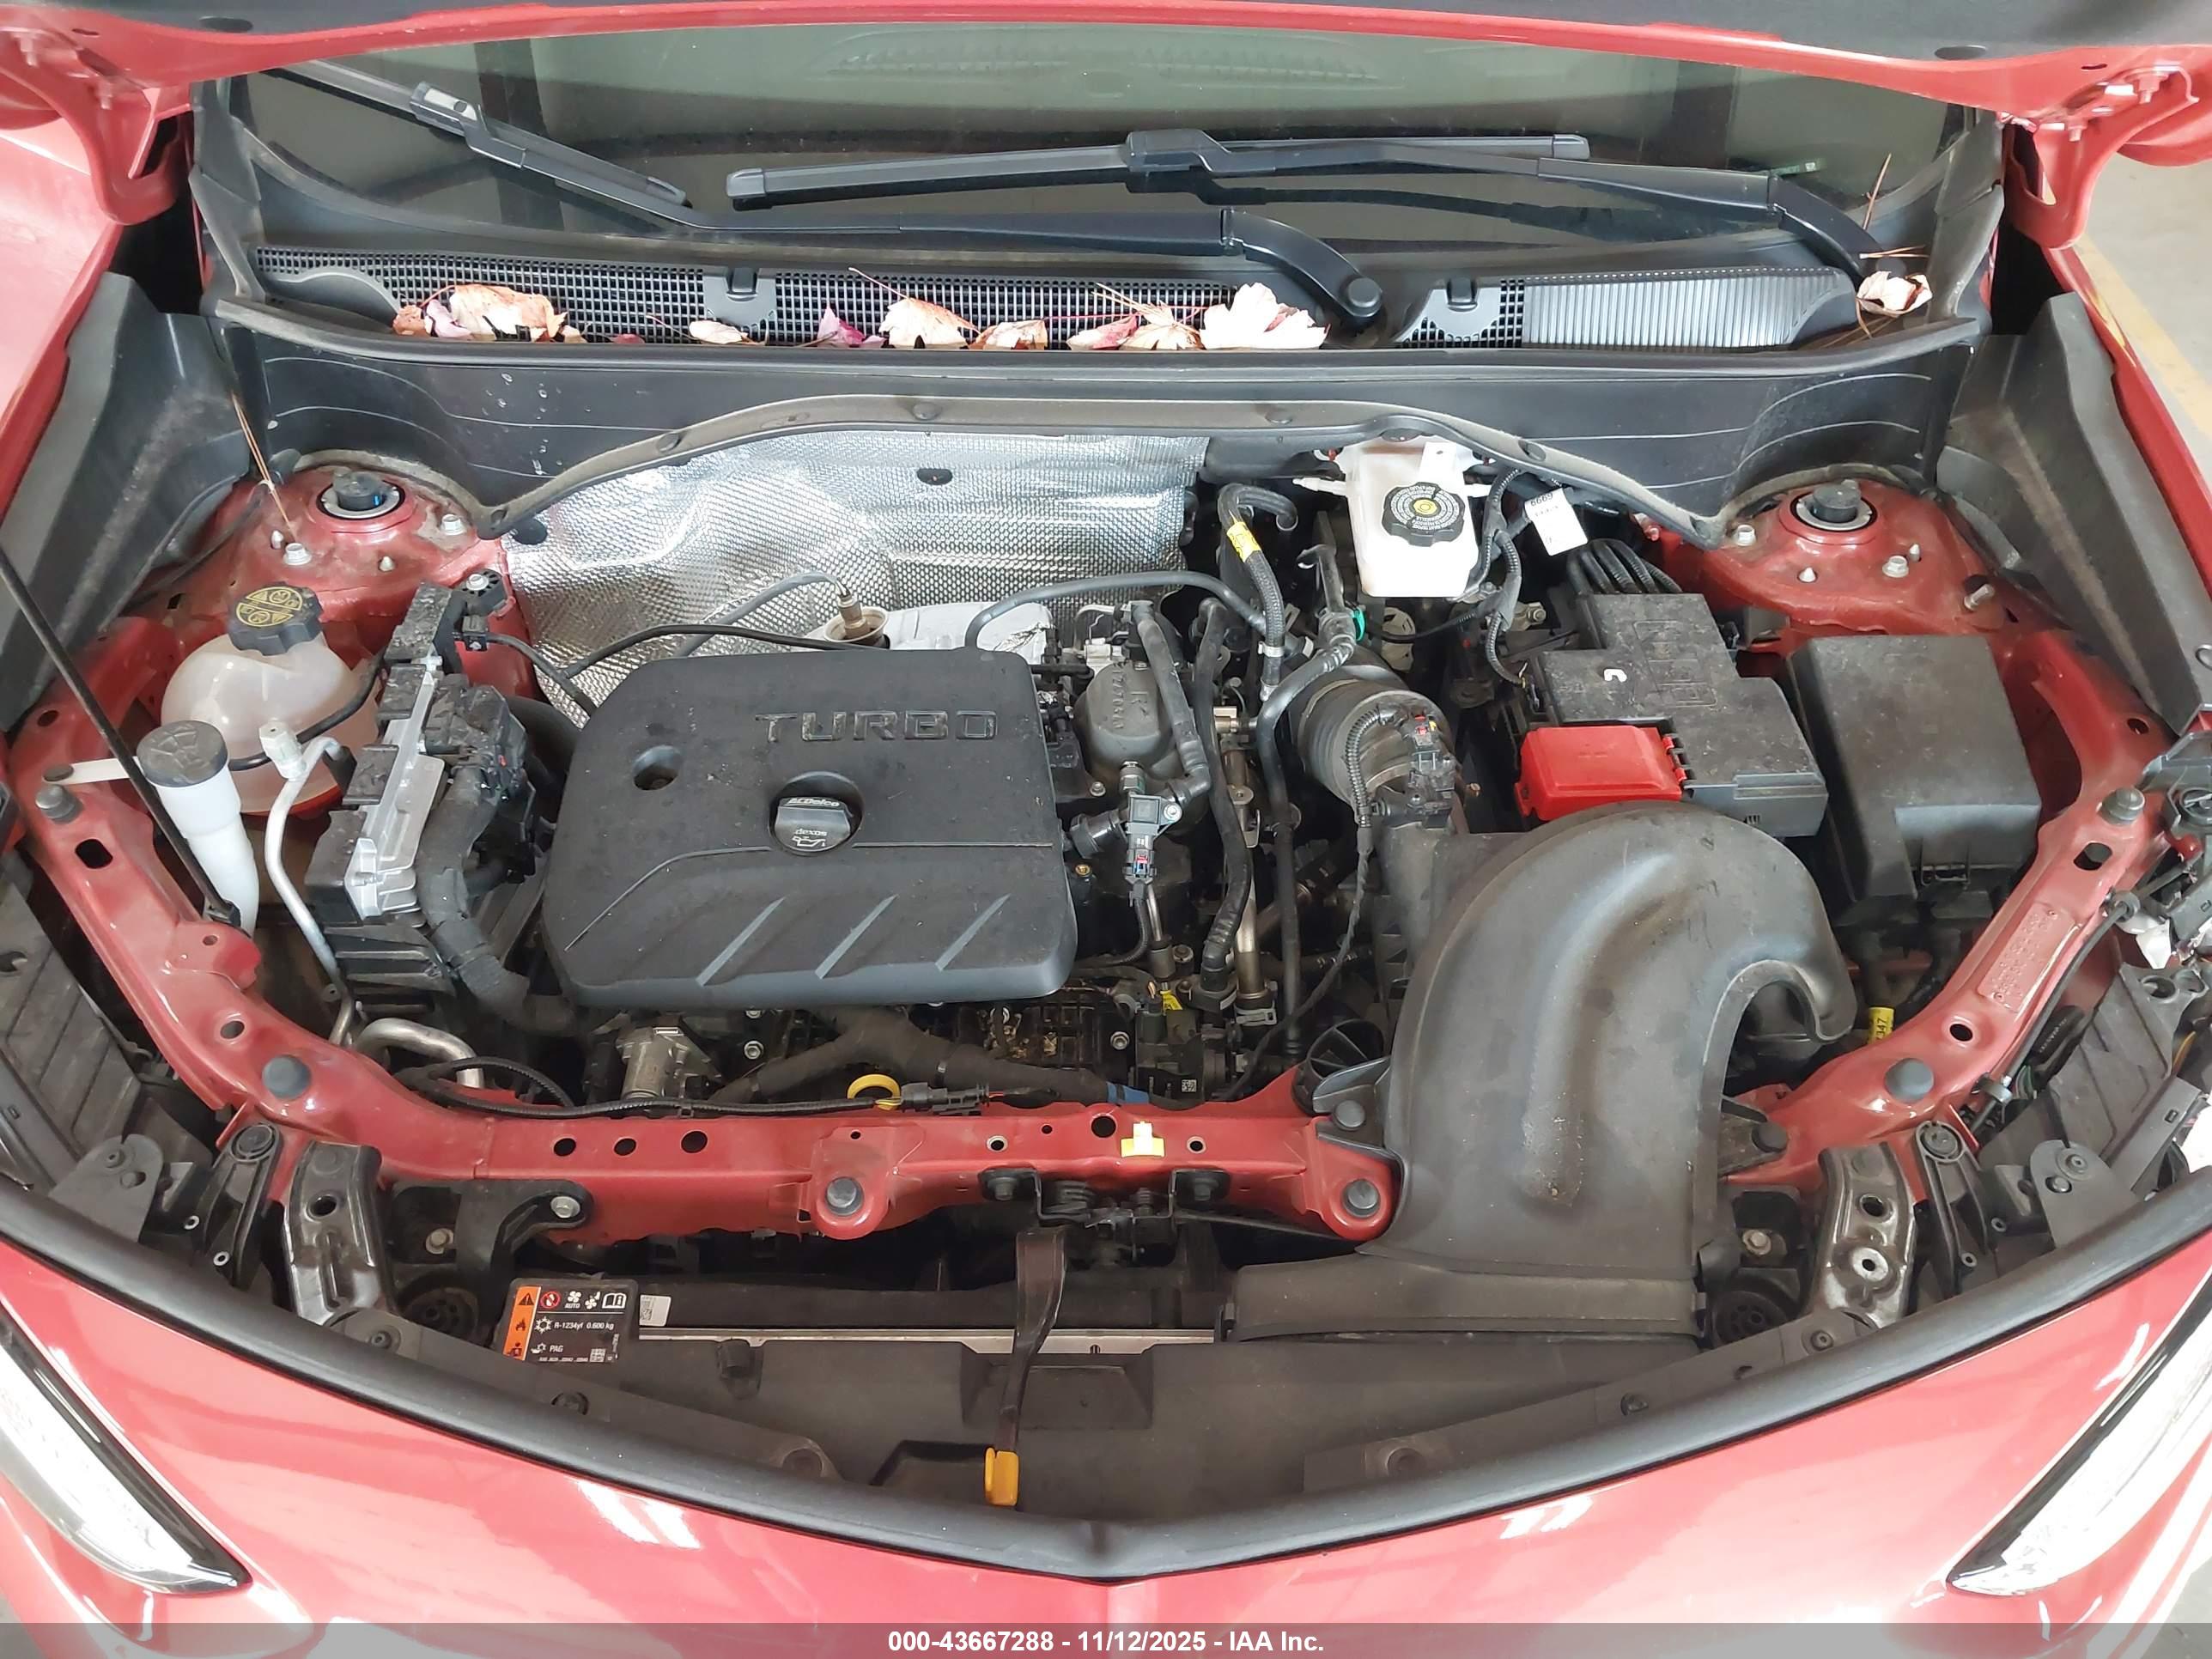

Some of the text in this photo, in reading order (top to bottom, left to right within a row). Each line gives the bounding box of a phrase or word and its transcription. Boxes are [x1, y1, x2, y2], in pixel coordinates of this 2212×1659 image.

[754, 710, 998, 742] TURBO
[787, 797, 840, 807] ACDelco
[794, 828, 828, 836] dexos
[554, 1322, 584, 1330] R-1234yf
[605, 1322, 615, 1331] kg
